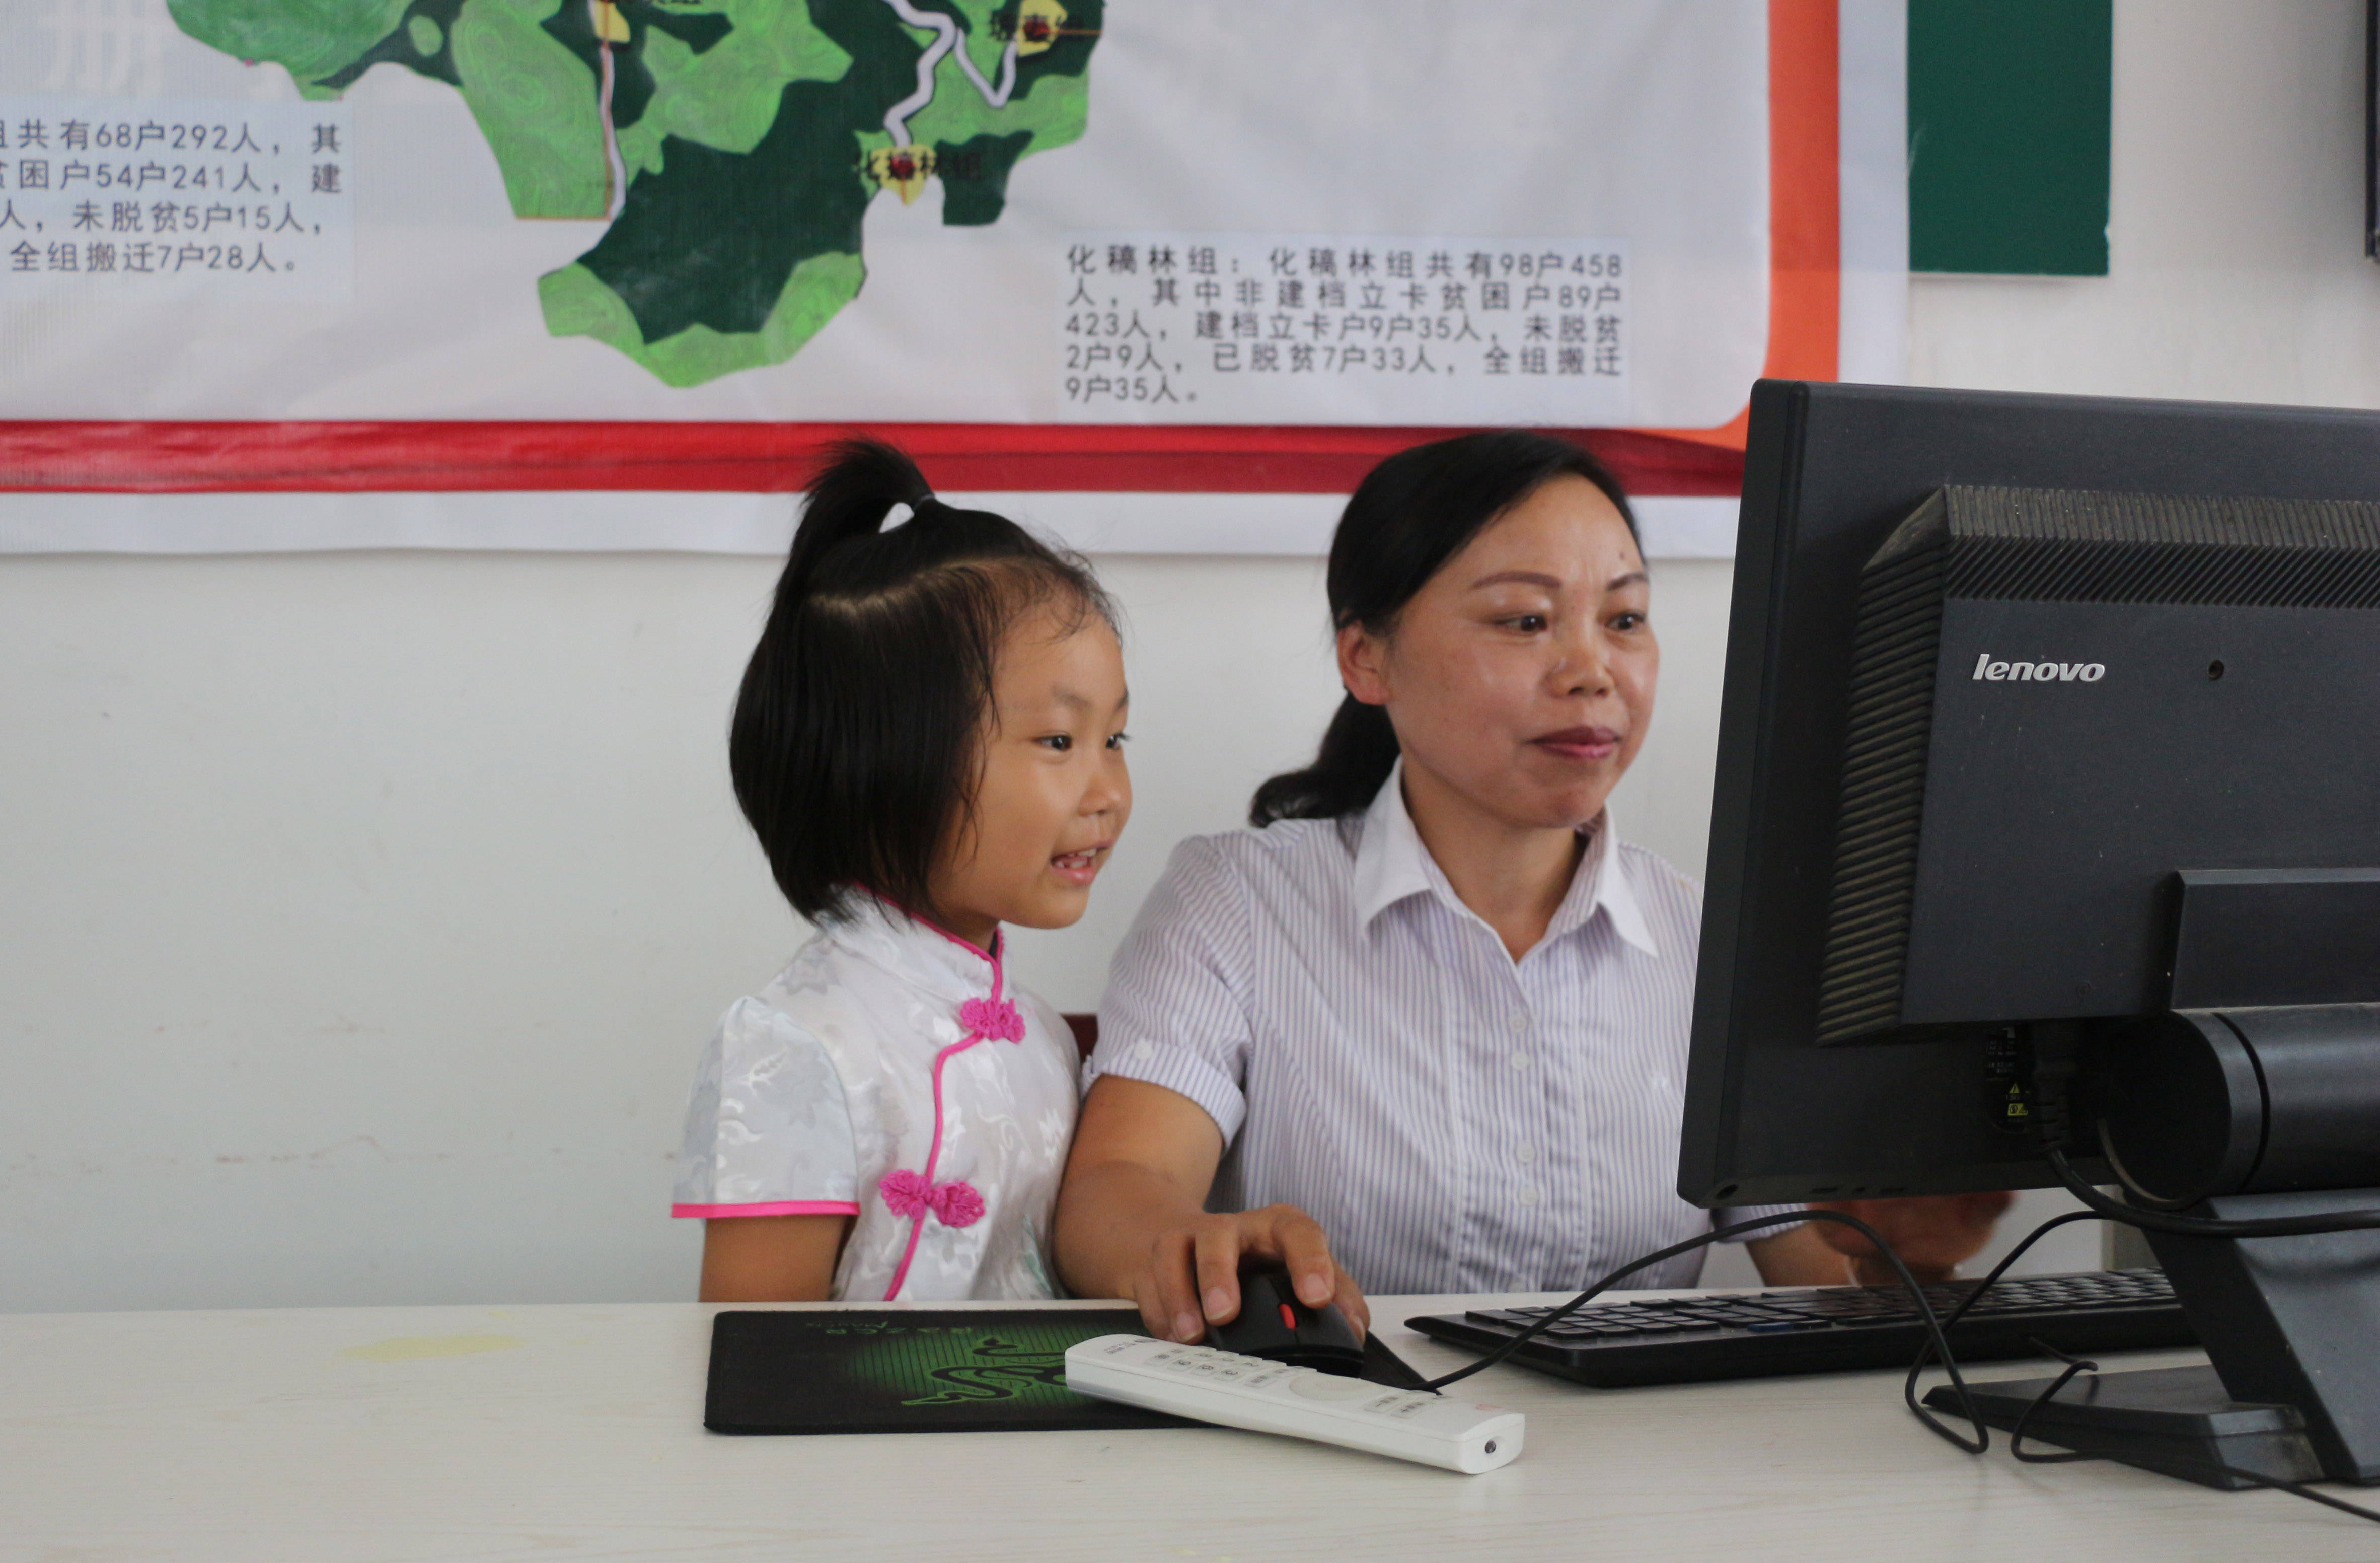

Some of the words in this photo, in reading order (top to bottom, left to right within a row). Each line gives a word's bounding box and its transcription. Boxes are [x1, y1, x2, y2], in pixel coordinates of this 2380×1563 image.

[0, 158, 342, 195] 困户54户241人，建
[1972, 654, 2105, 682] lenovo
